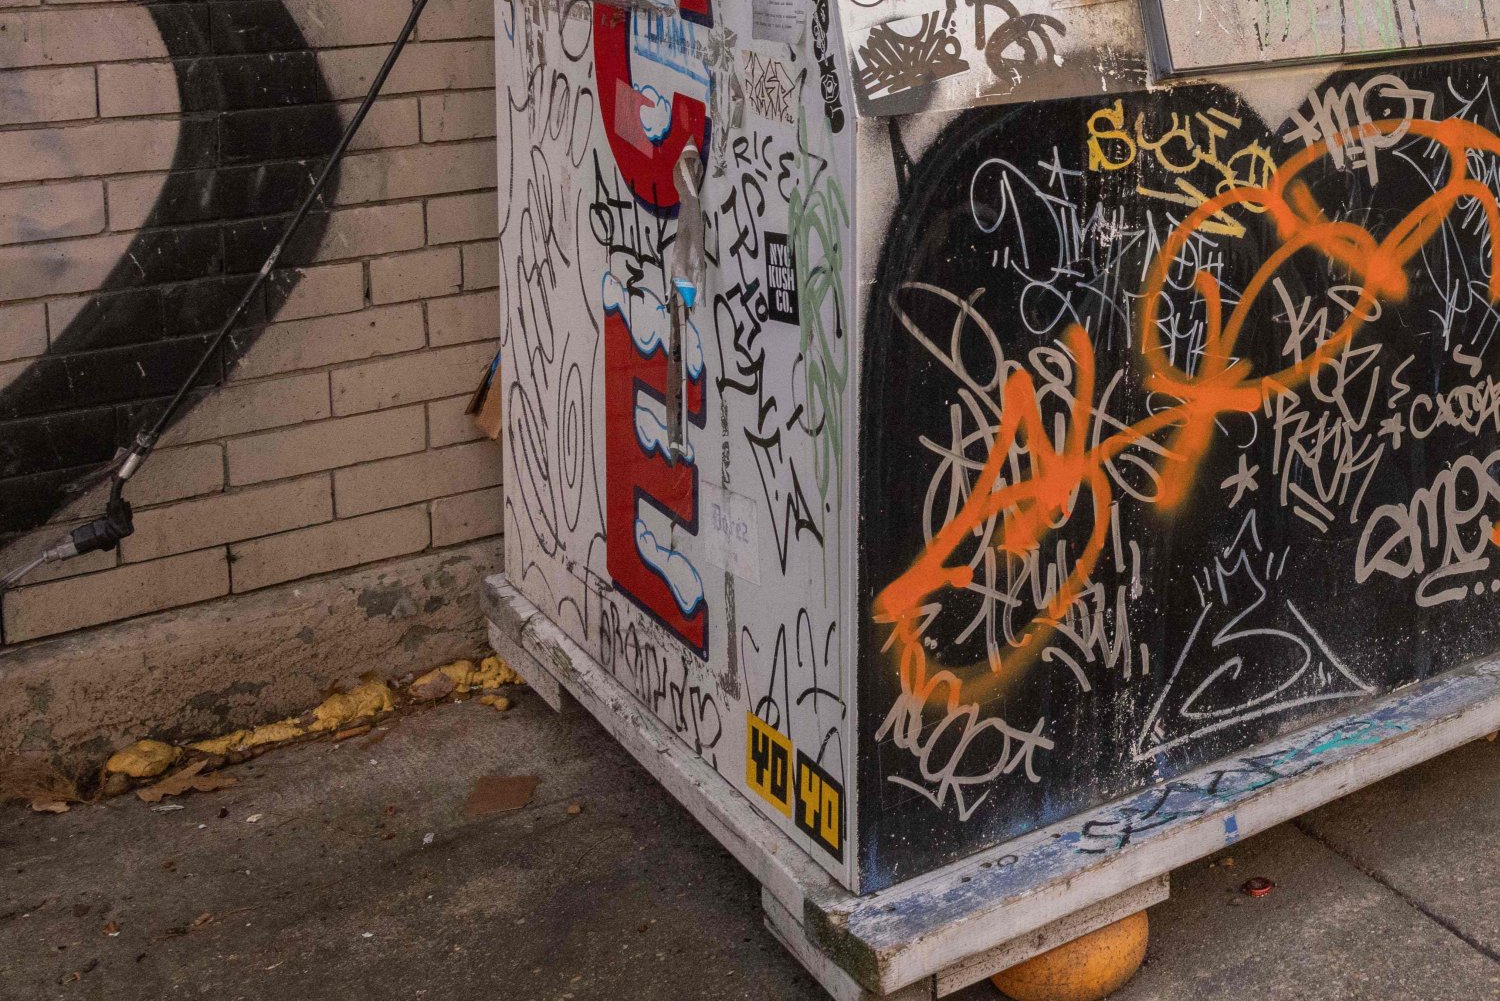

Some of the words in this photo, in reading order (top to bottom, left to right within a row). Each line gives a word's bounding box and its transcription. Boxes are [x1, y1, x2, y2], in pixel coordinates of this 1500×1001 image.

[768, 242, 794, 269] NYC
[768, 264, 796, 292] KUSH
[775, 291, 793, 315] CO.
